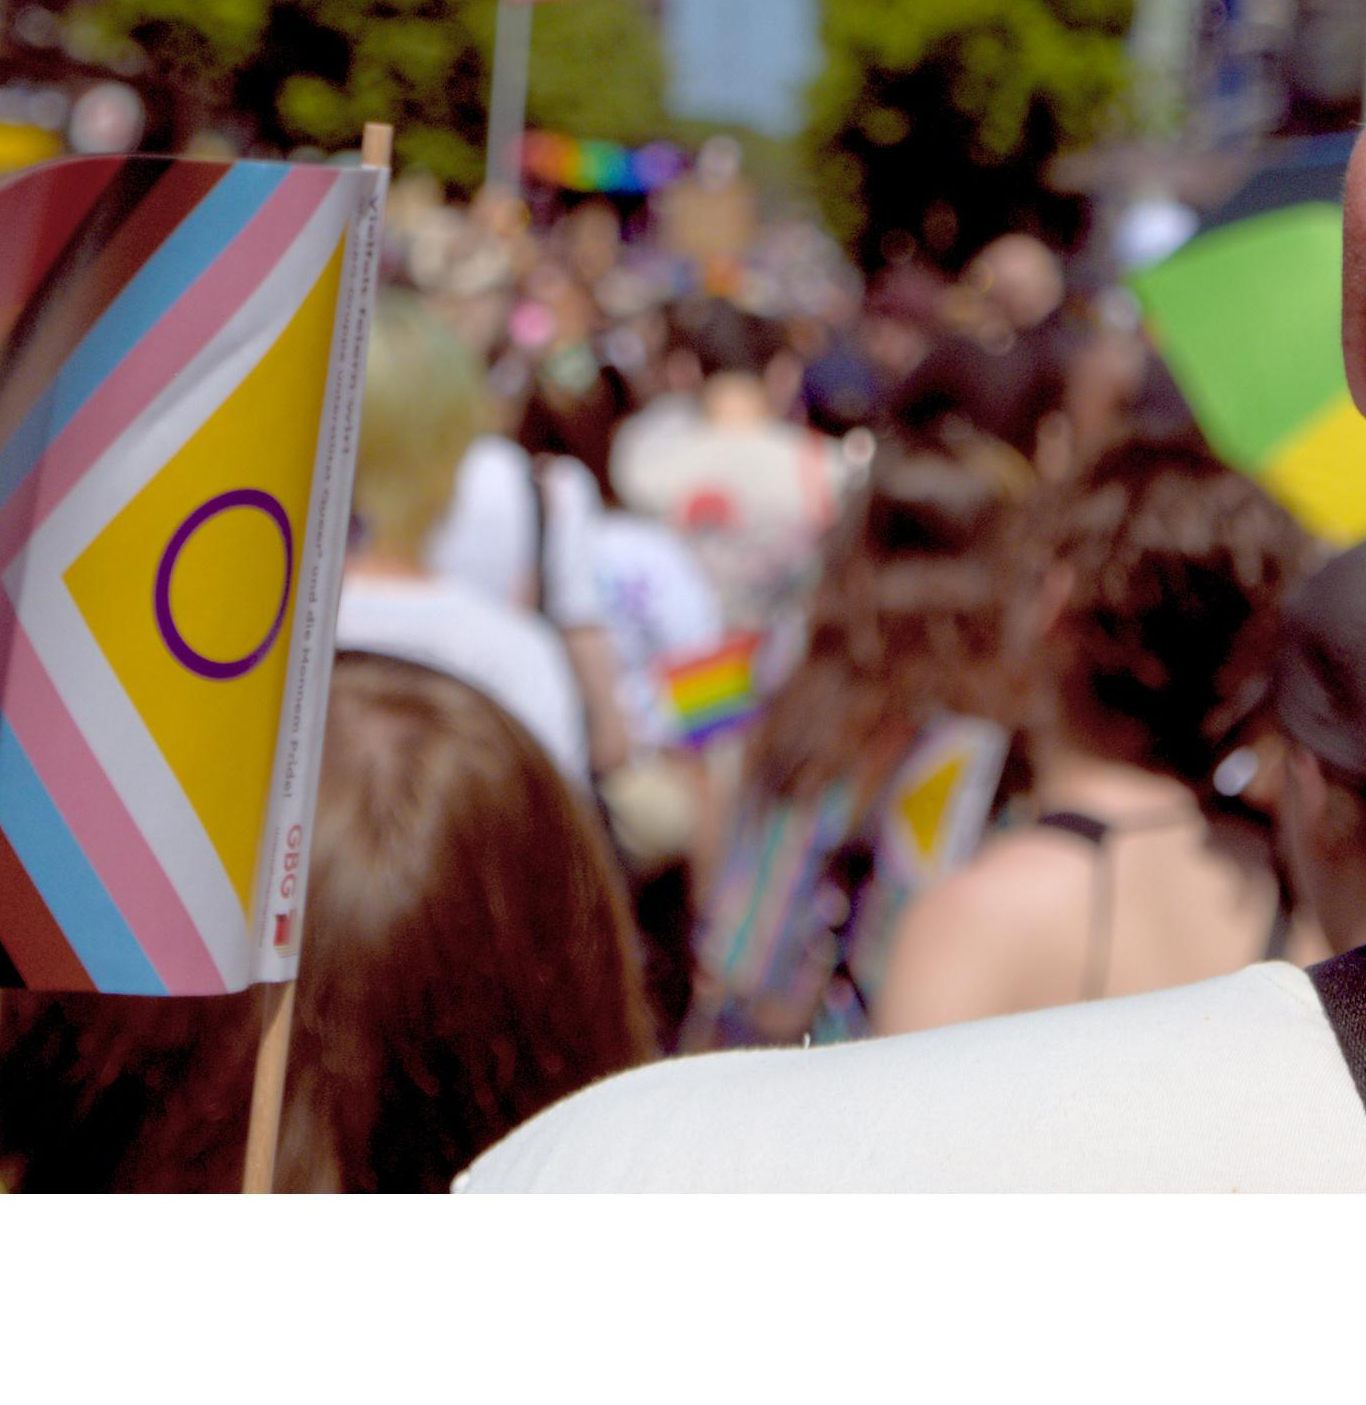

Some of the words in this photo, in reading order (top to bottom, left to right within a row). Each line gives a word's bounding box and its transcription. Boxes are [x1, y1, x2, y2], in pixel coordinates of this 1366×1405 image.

[361, 195, 379, 294] Vielfalt
[350, 308, 367, 389] feiern
[307, 565, 320, 603] und
[303, 610, 316, 641] die
[292, 648, 311, 733] Monnem
[283, 739, 300, 797] Pride!
[280, 824, 303, 899] GBG
